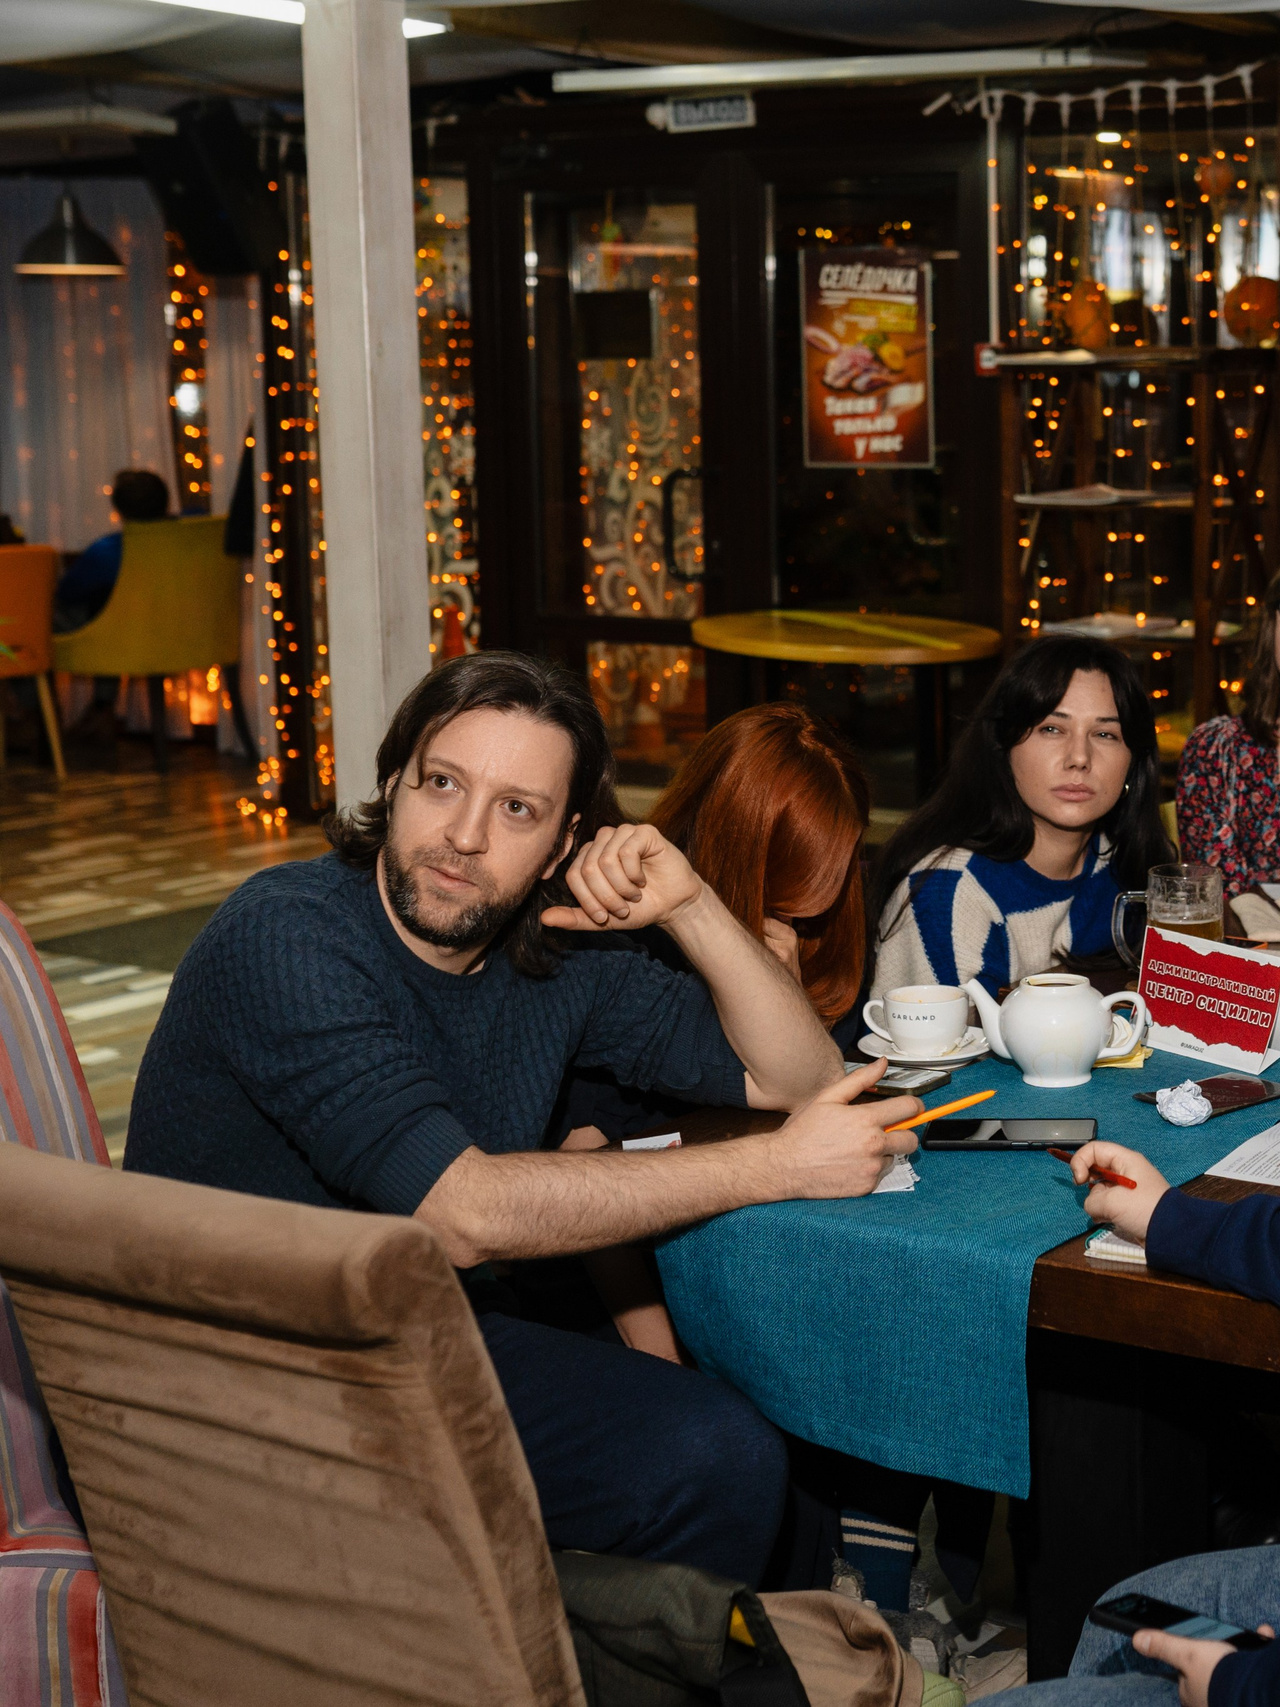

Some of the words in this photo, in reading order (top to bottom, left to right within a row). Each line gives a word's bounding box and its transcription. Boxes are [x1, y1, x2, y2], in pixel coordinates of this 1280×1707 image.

[819, 262, 918, 293] СЕЛЁДОЧКА
[1148, 959, 1276, 1003] АДМИНИСТРАТИВНЫЙ
[891, 1012, 936, 1021] GARLAND
[1145, 980, 1194, 1005] ЦЕНТР
[1196, 995, 1271, 1028] СИЦИЛИИ
